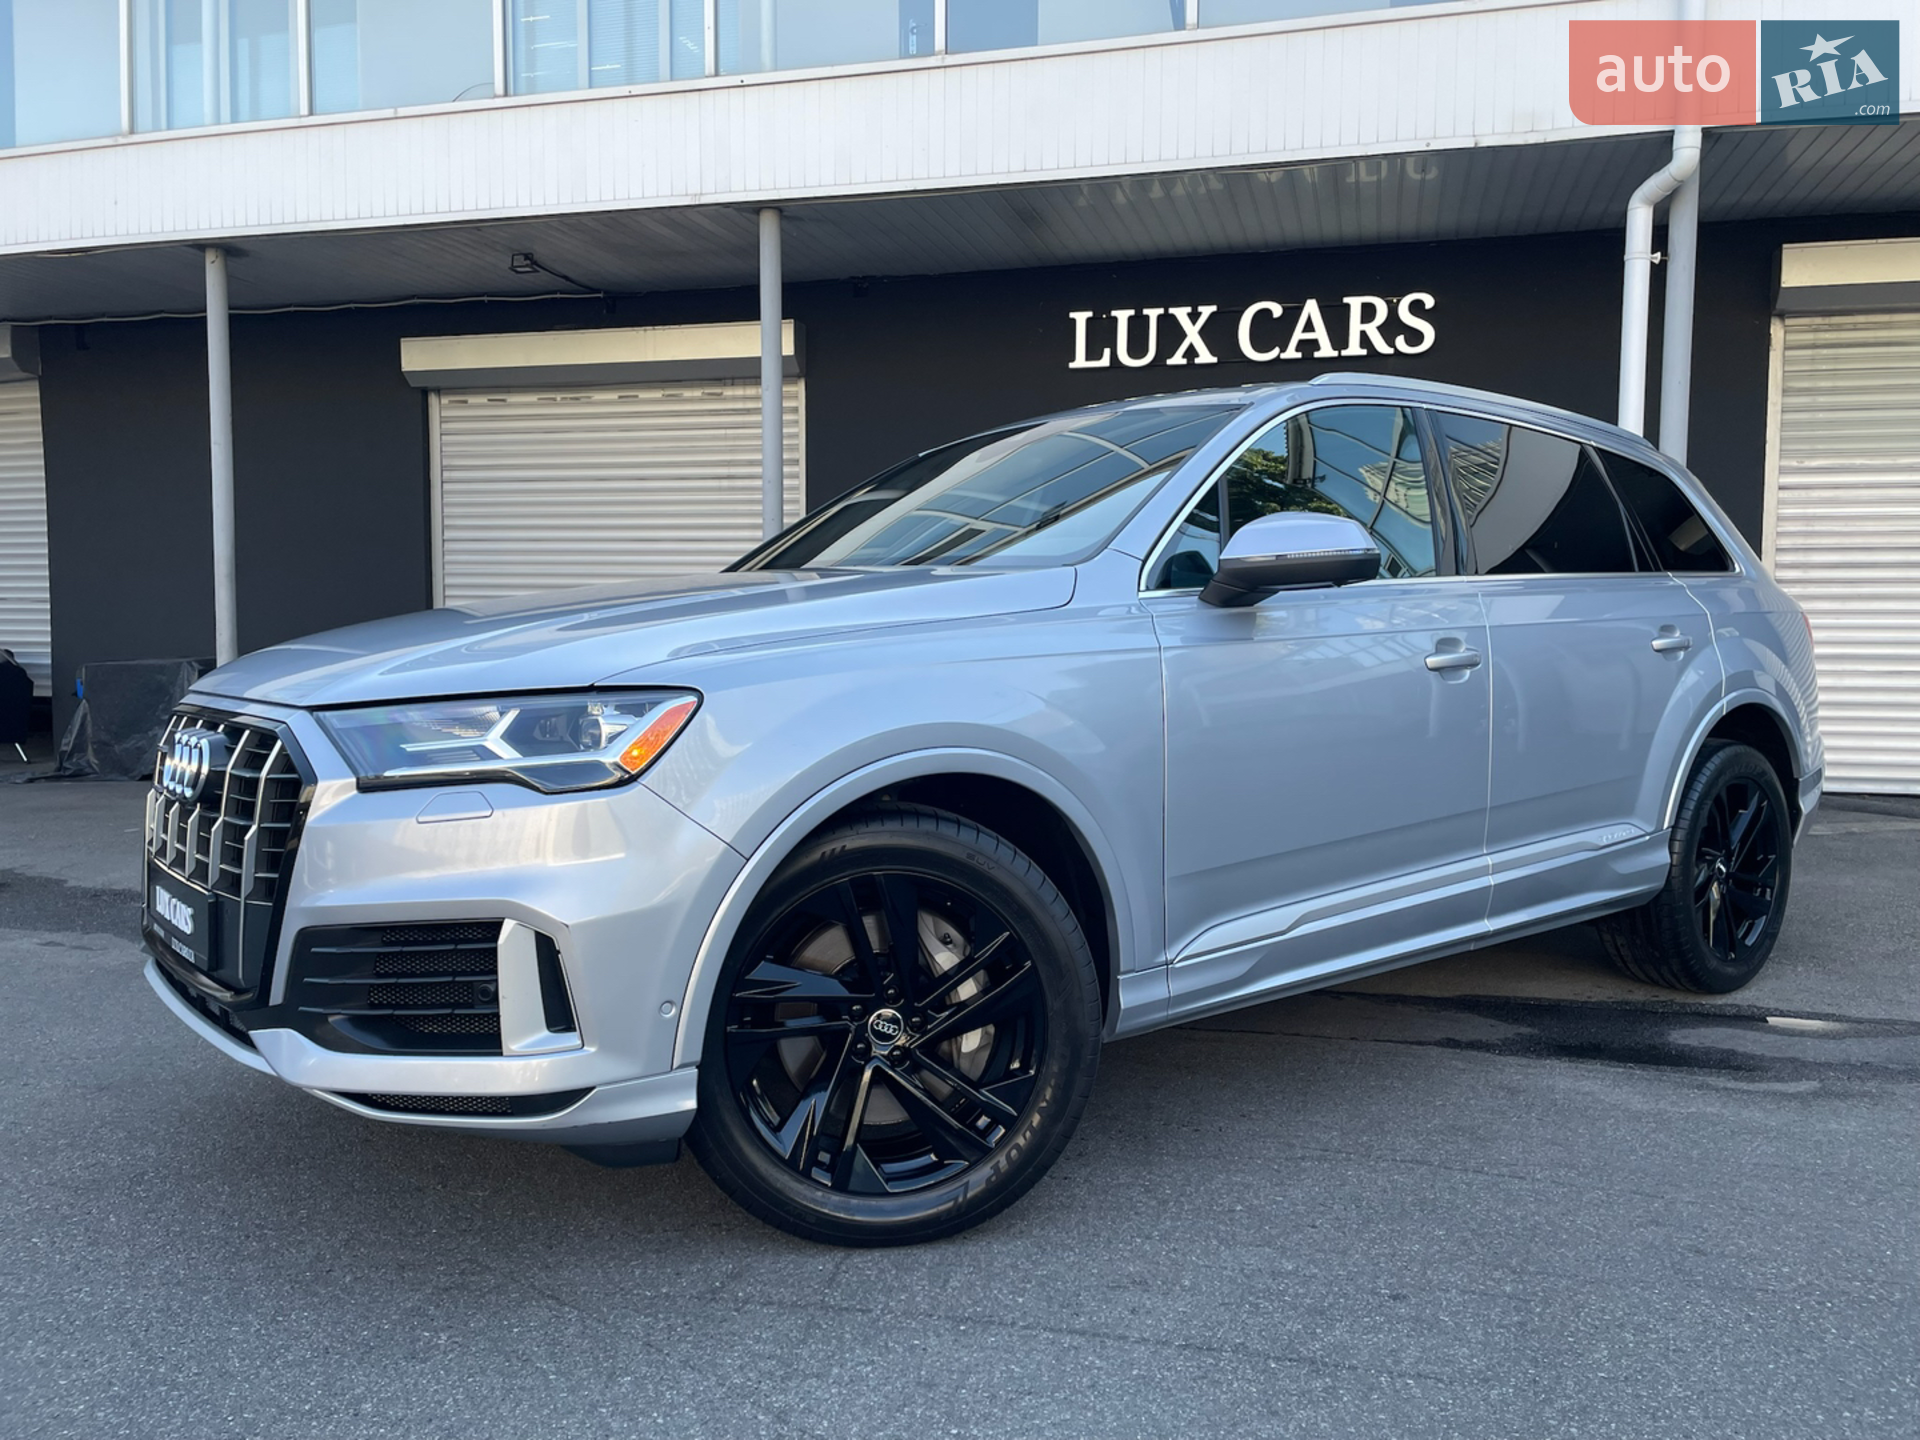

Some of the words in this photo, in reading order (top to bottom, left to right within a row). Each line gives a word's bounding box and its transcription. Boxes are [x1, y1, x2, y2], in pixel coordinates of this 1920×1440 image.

[1069, 305, 1217, 368] LUX
[1237, 292, 1436, 362] CARS
[965, 852, 995, 870] SUV
[984, 1043, 1070, 1188] DUNLOP
